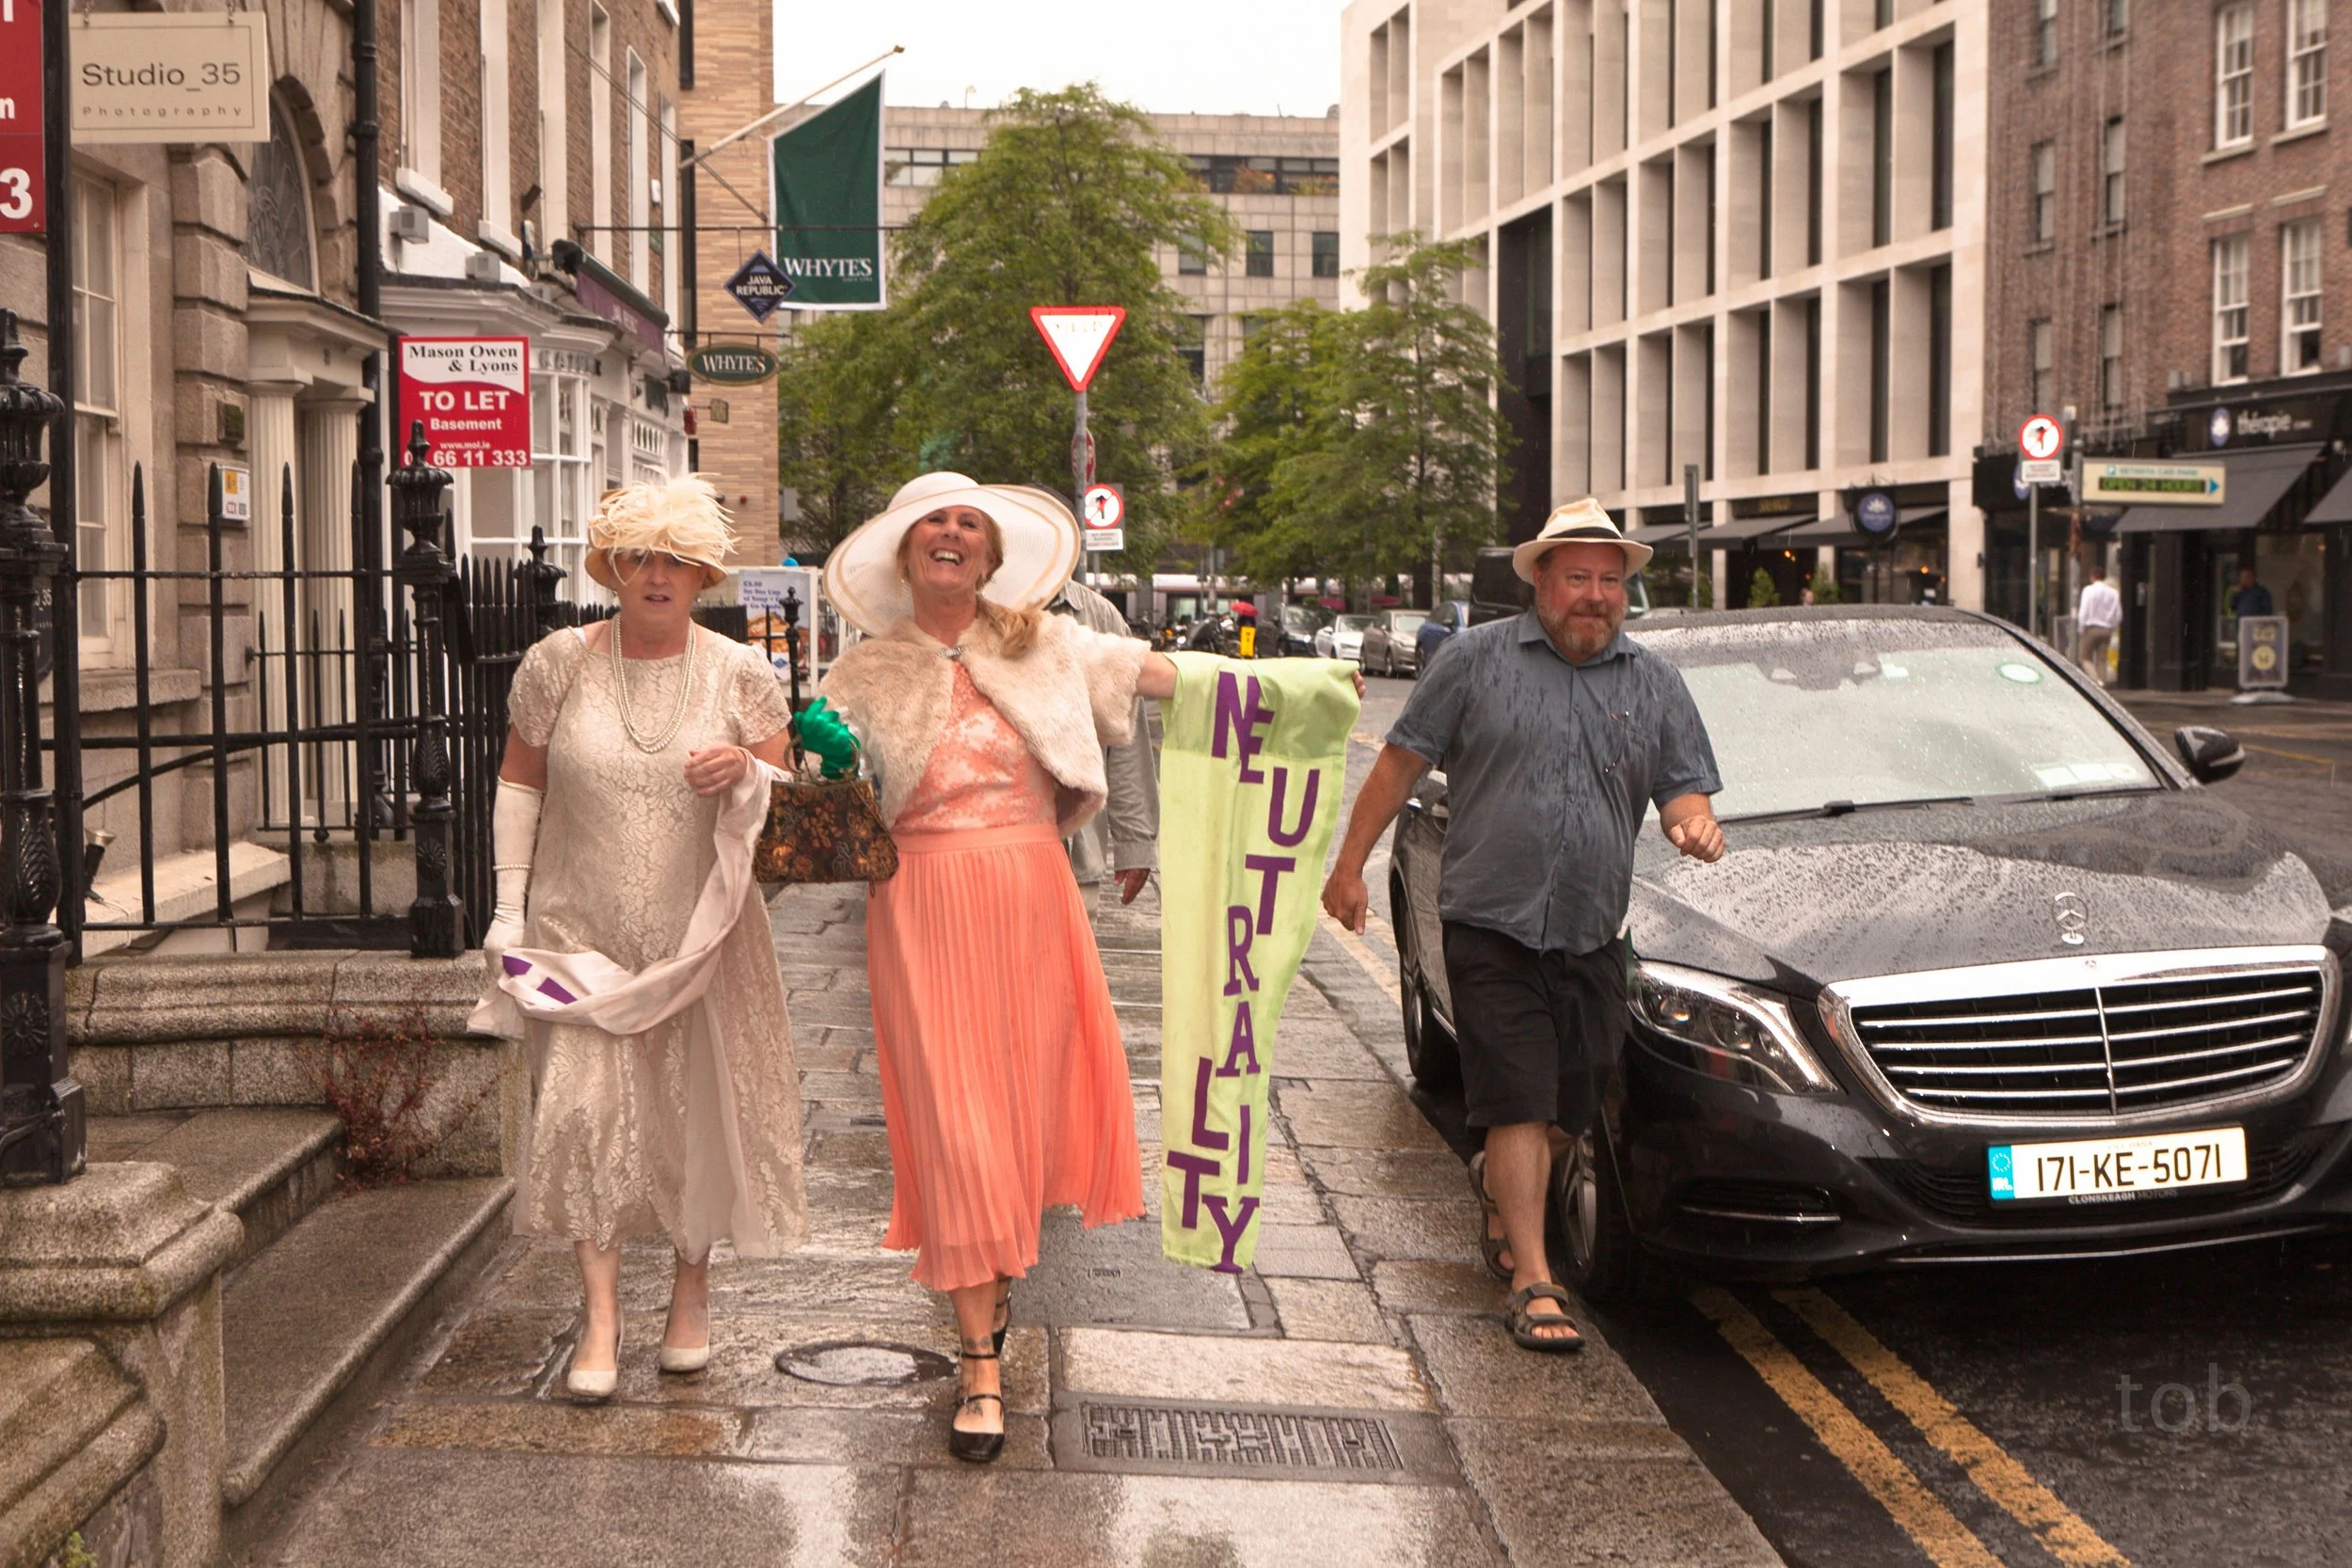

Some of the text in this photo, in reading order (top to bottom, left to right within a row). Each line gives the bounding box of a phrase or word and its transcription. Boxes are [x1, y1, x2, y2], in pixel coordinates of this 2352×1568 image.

[82, 62, 241, 92] Studio_35
[82, 105, 242, 118] Photography
[747, 275, 772, 285] JAVA
[736, 284, 785, 296] REPUBLIC
[1055, 321, 1102, 333] YIELD
[409, 345, 517, 357] Mason Owen
[448, 359, 518, 375] & Lyons
[419, 390, 510, 411] TO LET
[430, 418, 502, 430] Basement
[439, 440, 491, 450] www.mol.ie
[433, 450, 457, 467] 66
[463, 451, 485, 467] 11
[492, 450, 527, 467] 333
[2037, 1143, 2222, 1192] 171-KE-5071
[2137, 1188, 2179, 1200] MOTORS
